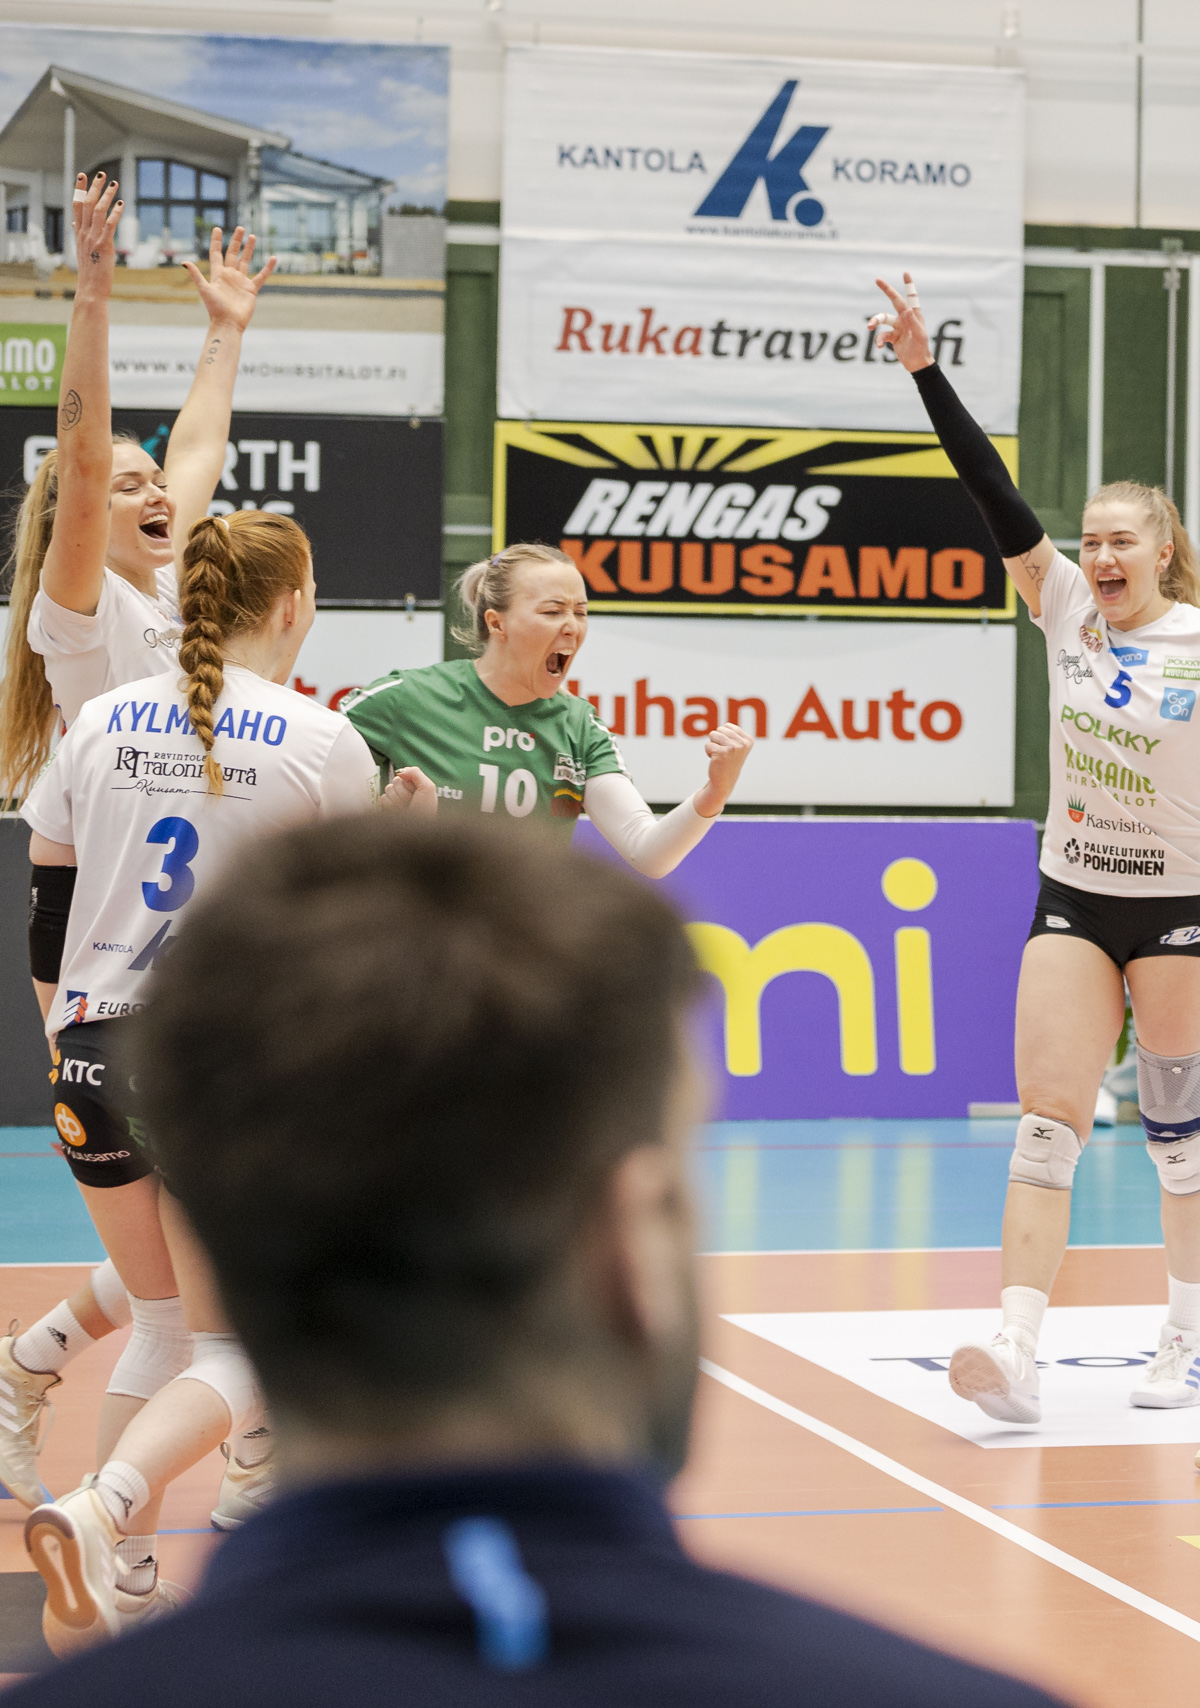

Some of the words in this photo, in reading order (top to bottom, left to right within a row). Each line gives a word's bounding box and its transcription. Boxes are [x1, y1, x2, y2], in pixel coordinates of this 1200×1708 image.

[557, 143, 707, 174] KANTOLA
[832, 157, 972, 187] KORAMO
[556, 306, 966, 366] Rukatravelsfi
[562, 477, 843, 542] RENGAS
[560, 539, 987, 601] KUUSAMO
[1104, 669, 1133, 709] 5
[1167, 691, 1188, 704] Go
[106, 700, 287, 747] KYLMAHO
[784, 685, 963, 742] Auto
[1169, 704, 1190, 717] On
[483, 725, 535, 753] pro
[478, 763, 538, 818] 10
[1066, 772, 1157, 807] HIRSALOT
[1086, 813, 1158, 837] KasvisHo
[142, 816, 199, 912] 3
[1083, 853, 1166, 877] POHJOINEN
[1084, 841, 1166, 859] PALVELUTUKKU
[92, 941, 134, 954] KANTOLA
[62, 1057, 106, 1086] KTC
